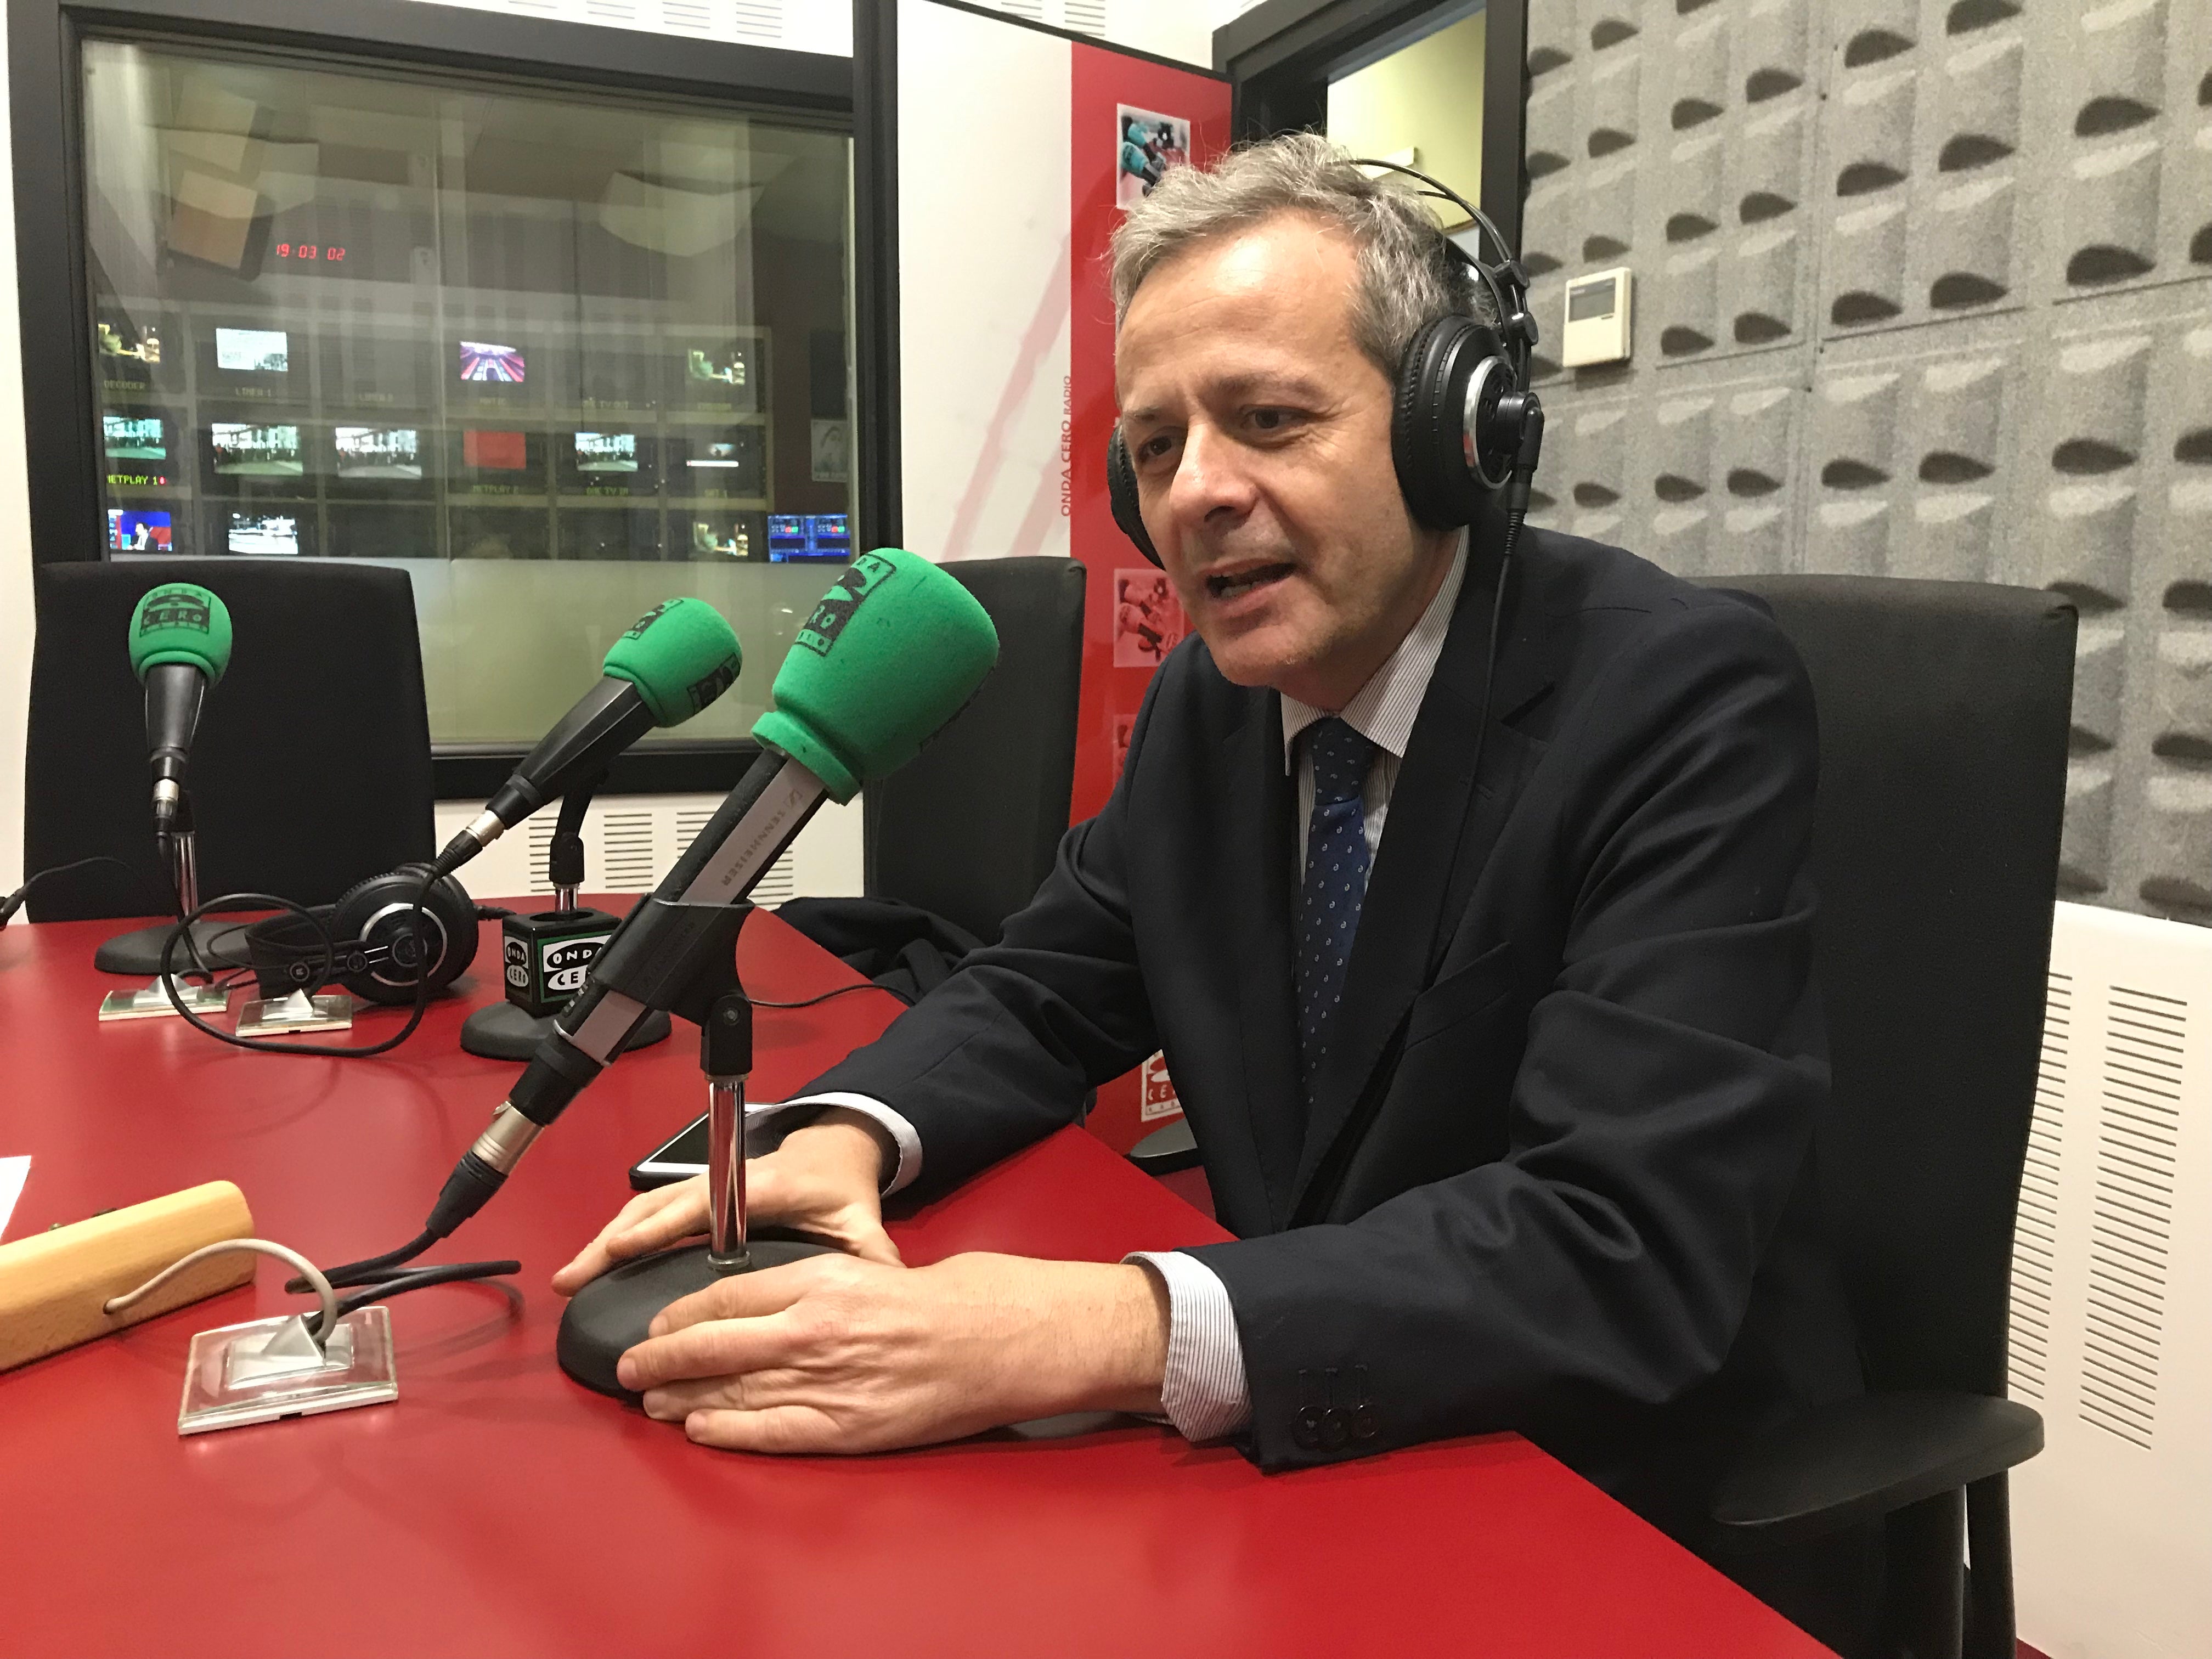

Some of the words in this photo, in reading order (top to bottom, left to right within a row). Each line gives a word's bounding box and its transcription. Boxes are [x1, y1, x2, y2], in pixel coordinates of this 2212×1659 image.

[1063, 375, 1071, 415] RADIO
[1061, 420, 1071, 463] CERO
[1061, 468, 1071, 516] ONDA
[721, 810, 787, 886] SENNHEISER
[506, 947, 525, 961] ONDA
[509, 968, 526, 984] CERO
